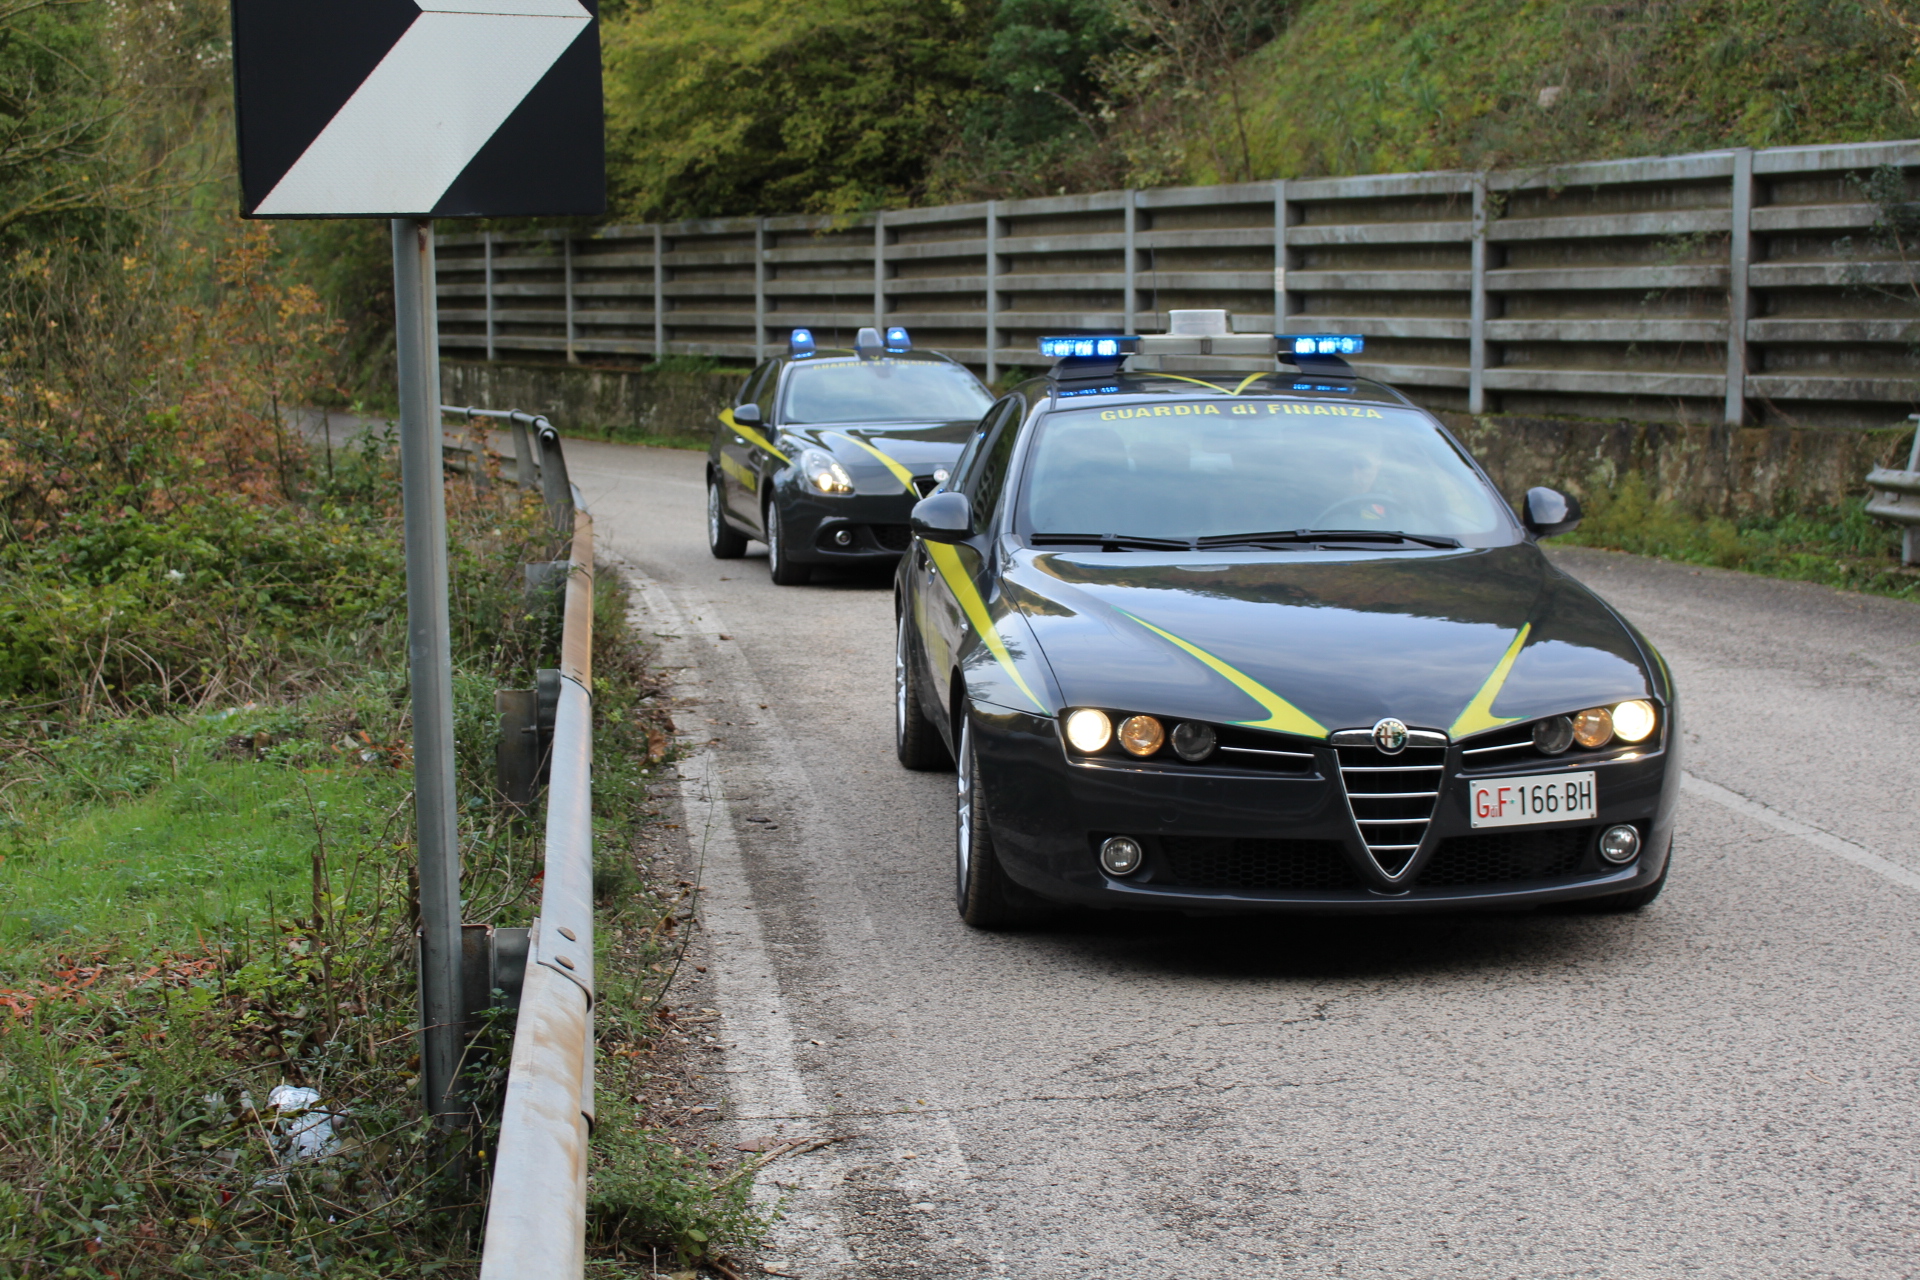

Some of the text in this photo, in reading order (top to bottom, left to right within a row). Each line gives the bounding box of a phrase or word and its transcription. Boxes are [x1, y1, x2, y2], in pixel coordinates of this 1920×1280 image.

[1100, 403, 1383, 422] GUARDIA di FINANZA
